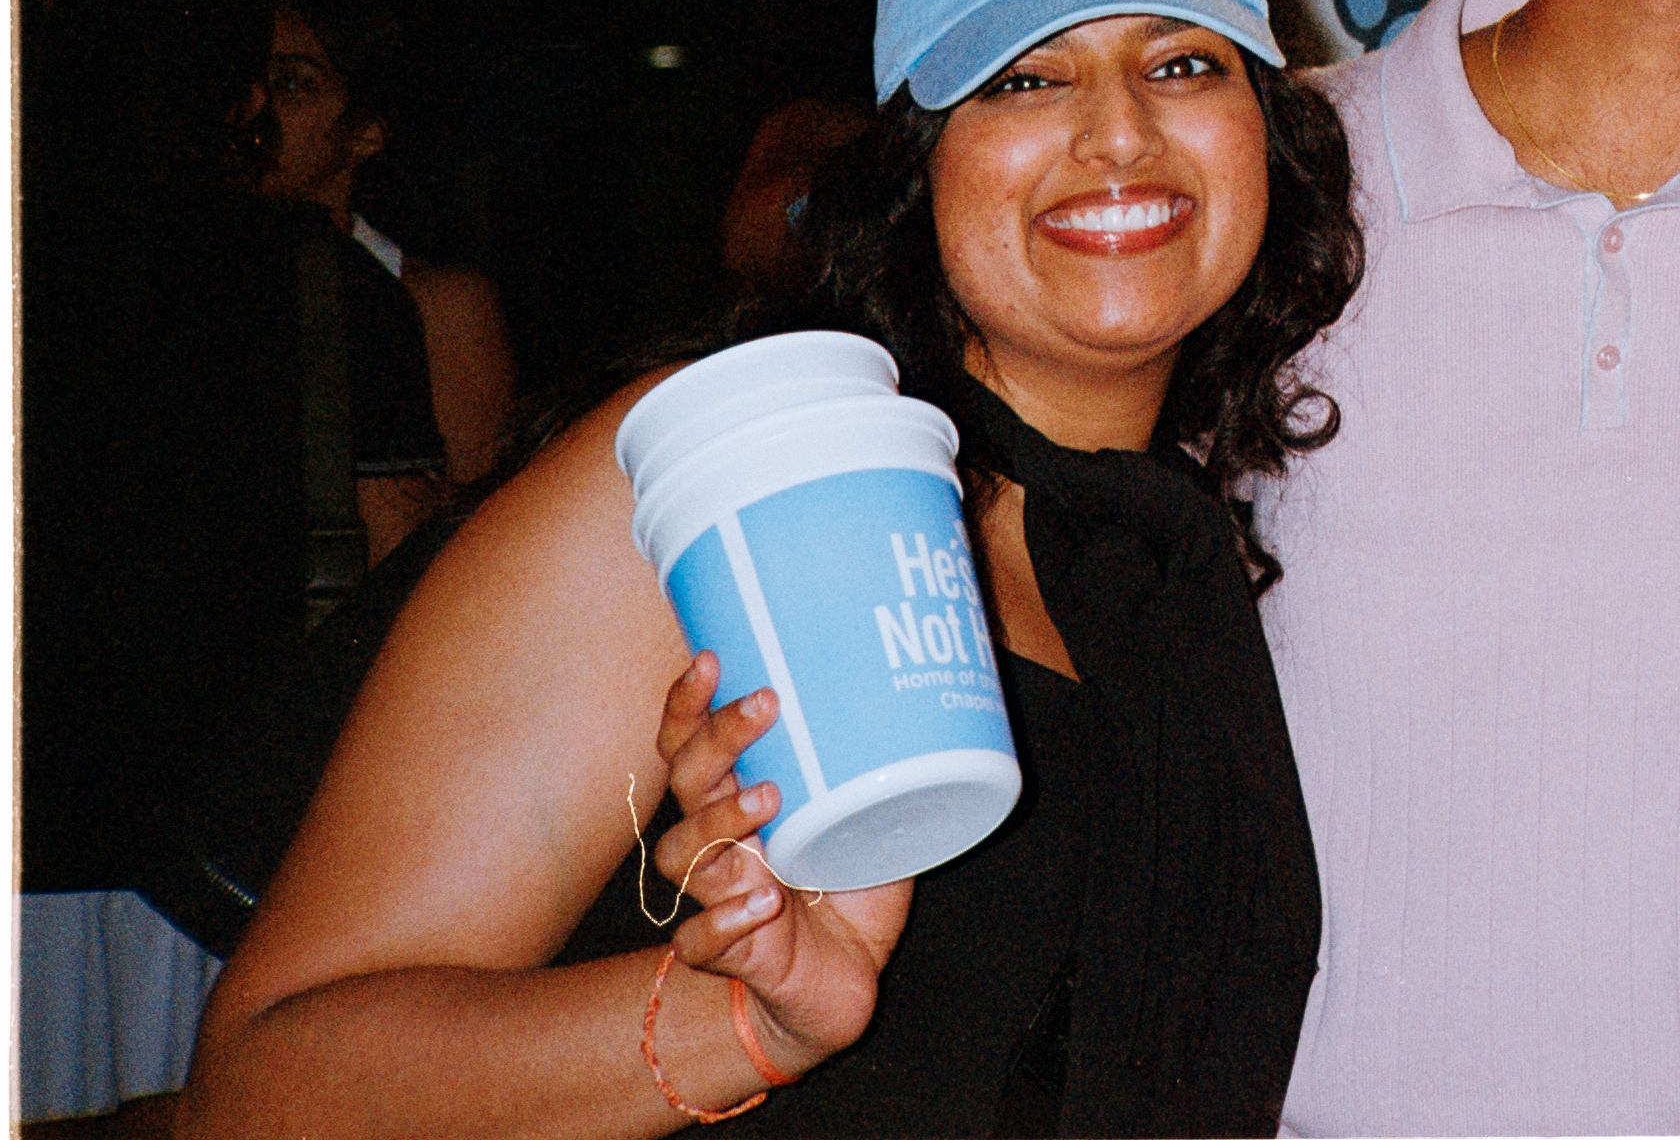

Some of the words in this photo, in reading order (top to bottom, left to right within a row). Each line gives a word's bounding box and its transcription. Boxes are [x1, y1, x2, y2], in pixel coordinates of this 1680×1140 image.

[889, 531, 979, 607] He's
[873, 601, 969, 669] Not
[891, 670, 955, 692] Home
[957, 668, 976, 688] of
